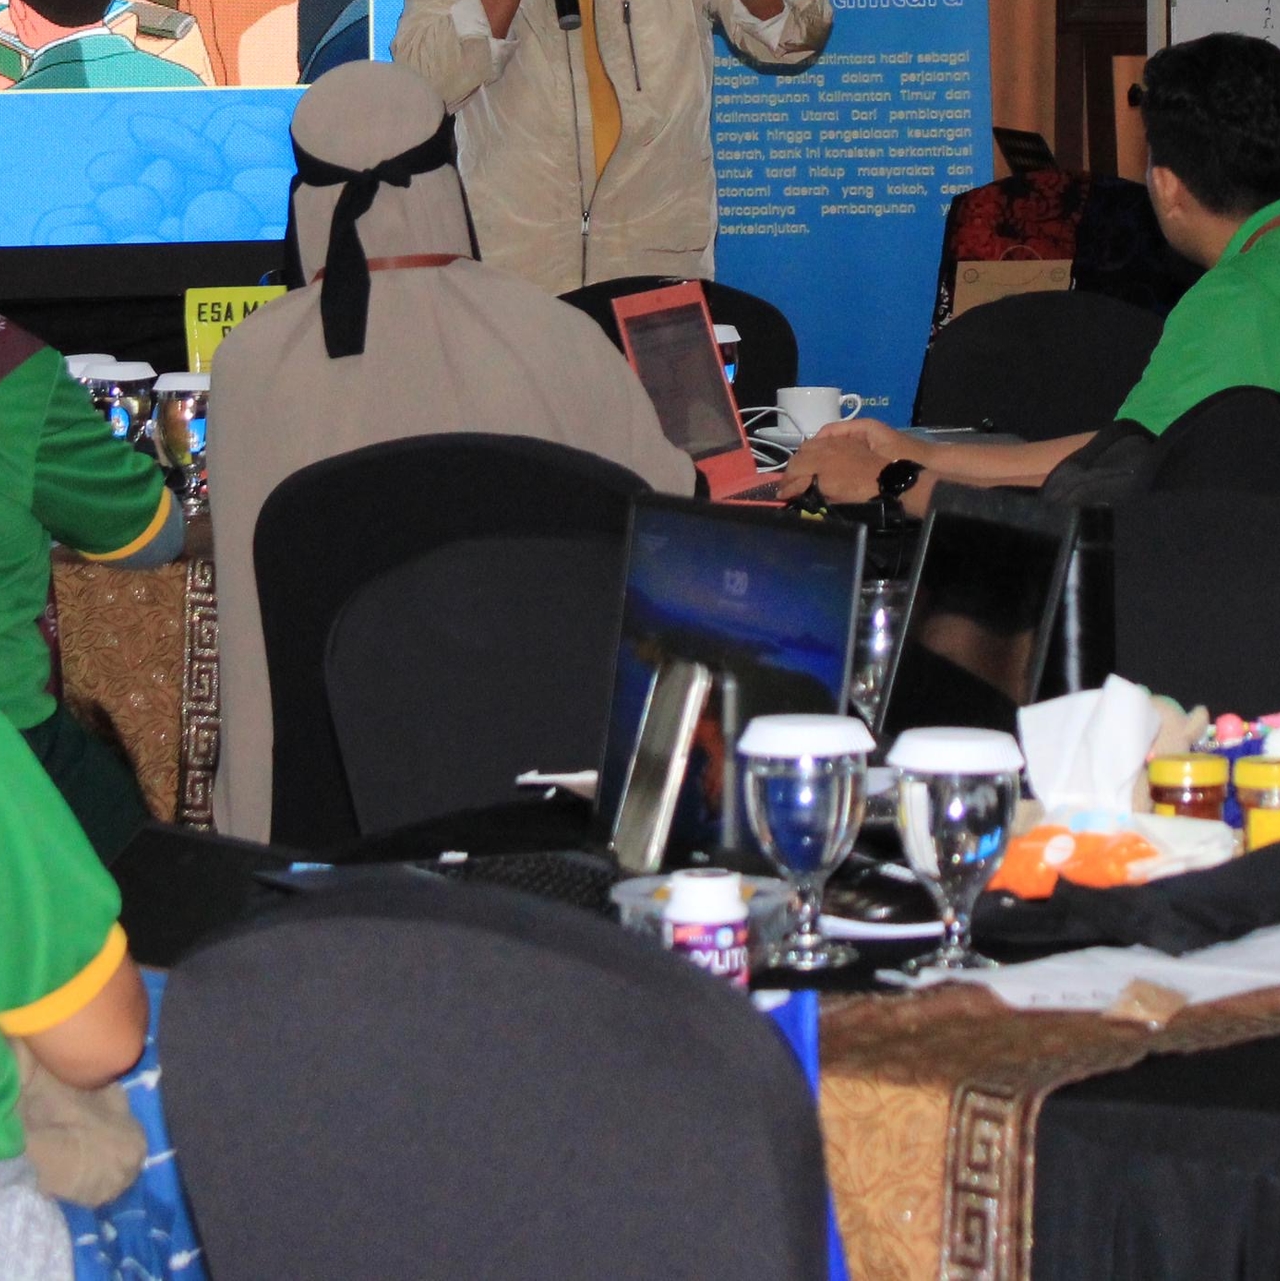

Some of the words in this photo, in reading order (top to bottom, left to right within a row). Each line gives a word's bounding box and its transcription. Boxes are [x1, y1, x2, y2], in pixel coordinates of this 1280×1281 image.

[818, 90, 891, 102] Kalimantan
[900, 89, 937, 101] Timur
[946, 88, 971, 100] dan
[716, 110, 789, 122] Kalimantan
[716, 130, 759, 144] proyek
[767, 129, 812, 143] hingga
[770, 148, 802, 160] bank
[717, 167, 753, 179] untuk
[809, 166, 845, 180] hidup
[857, 165, 935, 179] masyarakat
[947, 164, 973, 176] dan
[841, 185, 875, 198] yang
[821, 202, 916, 217] pembangunan
[198, 301, 234, 323] ESA
